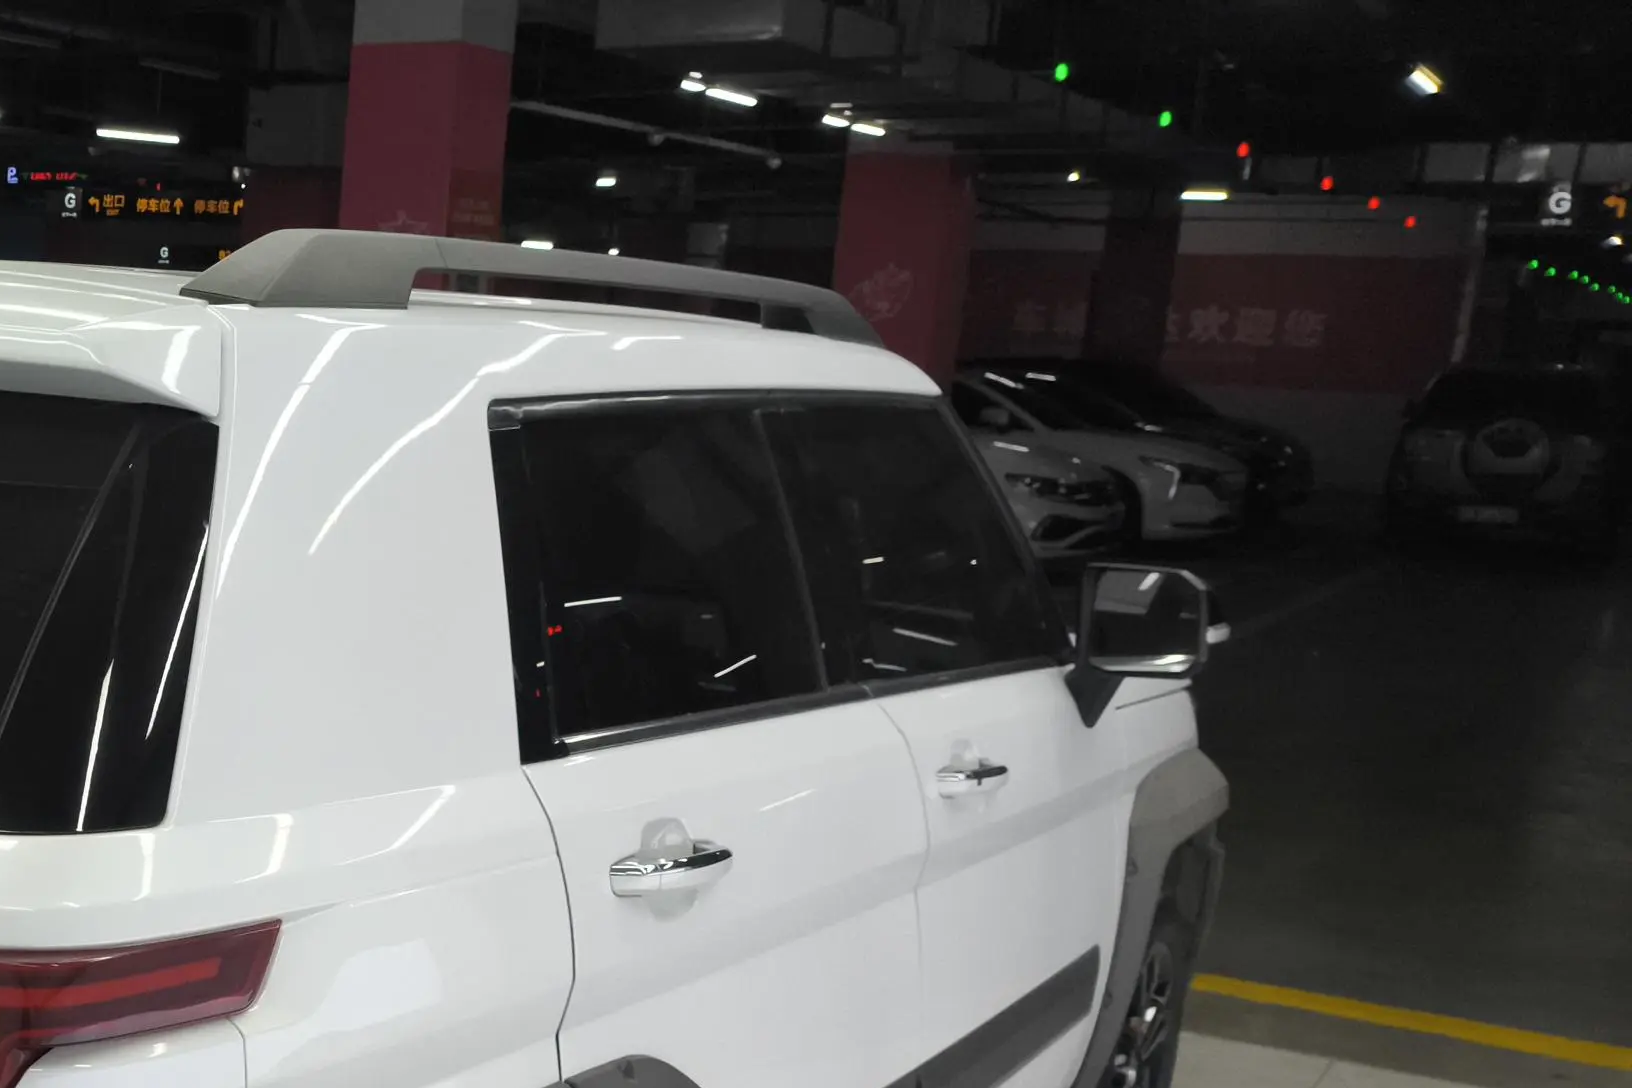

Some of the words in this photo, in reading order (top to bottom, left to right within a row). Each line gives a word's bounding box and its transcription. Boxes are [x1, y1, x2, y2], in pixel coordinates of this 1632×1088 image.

[64, 192, 76, 209] G
[103, 193, 125, 208] 出口
[136, 198, 170, 213] 停车位
[194, 199, 230, 214] 停车位
